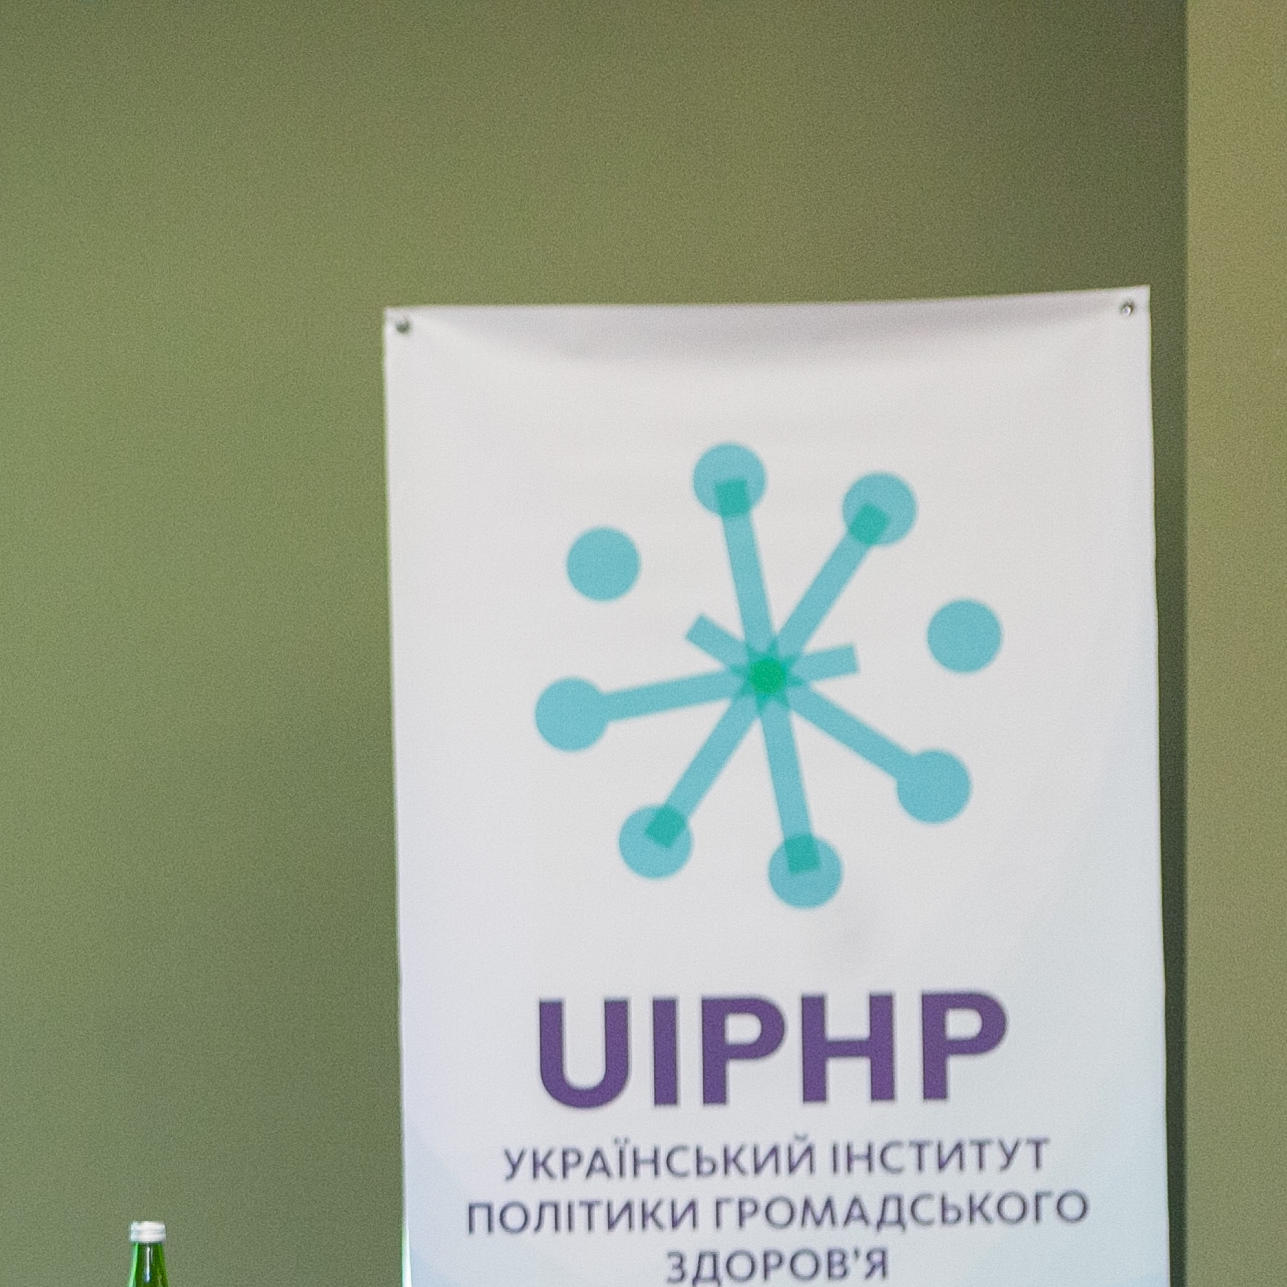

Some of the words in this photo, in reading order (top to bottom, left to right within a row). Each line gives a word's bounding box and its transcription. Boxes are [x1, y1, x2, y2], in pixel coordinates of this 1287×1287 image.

[538, 988, 1011, 1110] UIPHP
[503, 1134, 816, 1183] УКРАЇНСЬКИЙ
[831, 1137, 1051, 1176] ІНСТИТУТ
[467, 1195, 700, 1235] ПОЛІТИКИ
[714, 1188, 1091, 1234] ГРОМАДСЬКОГО
